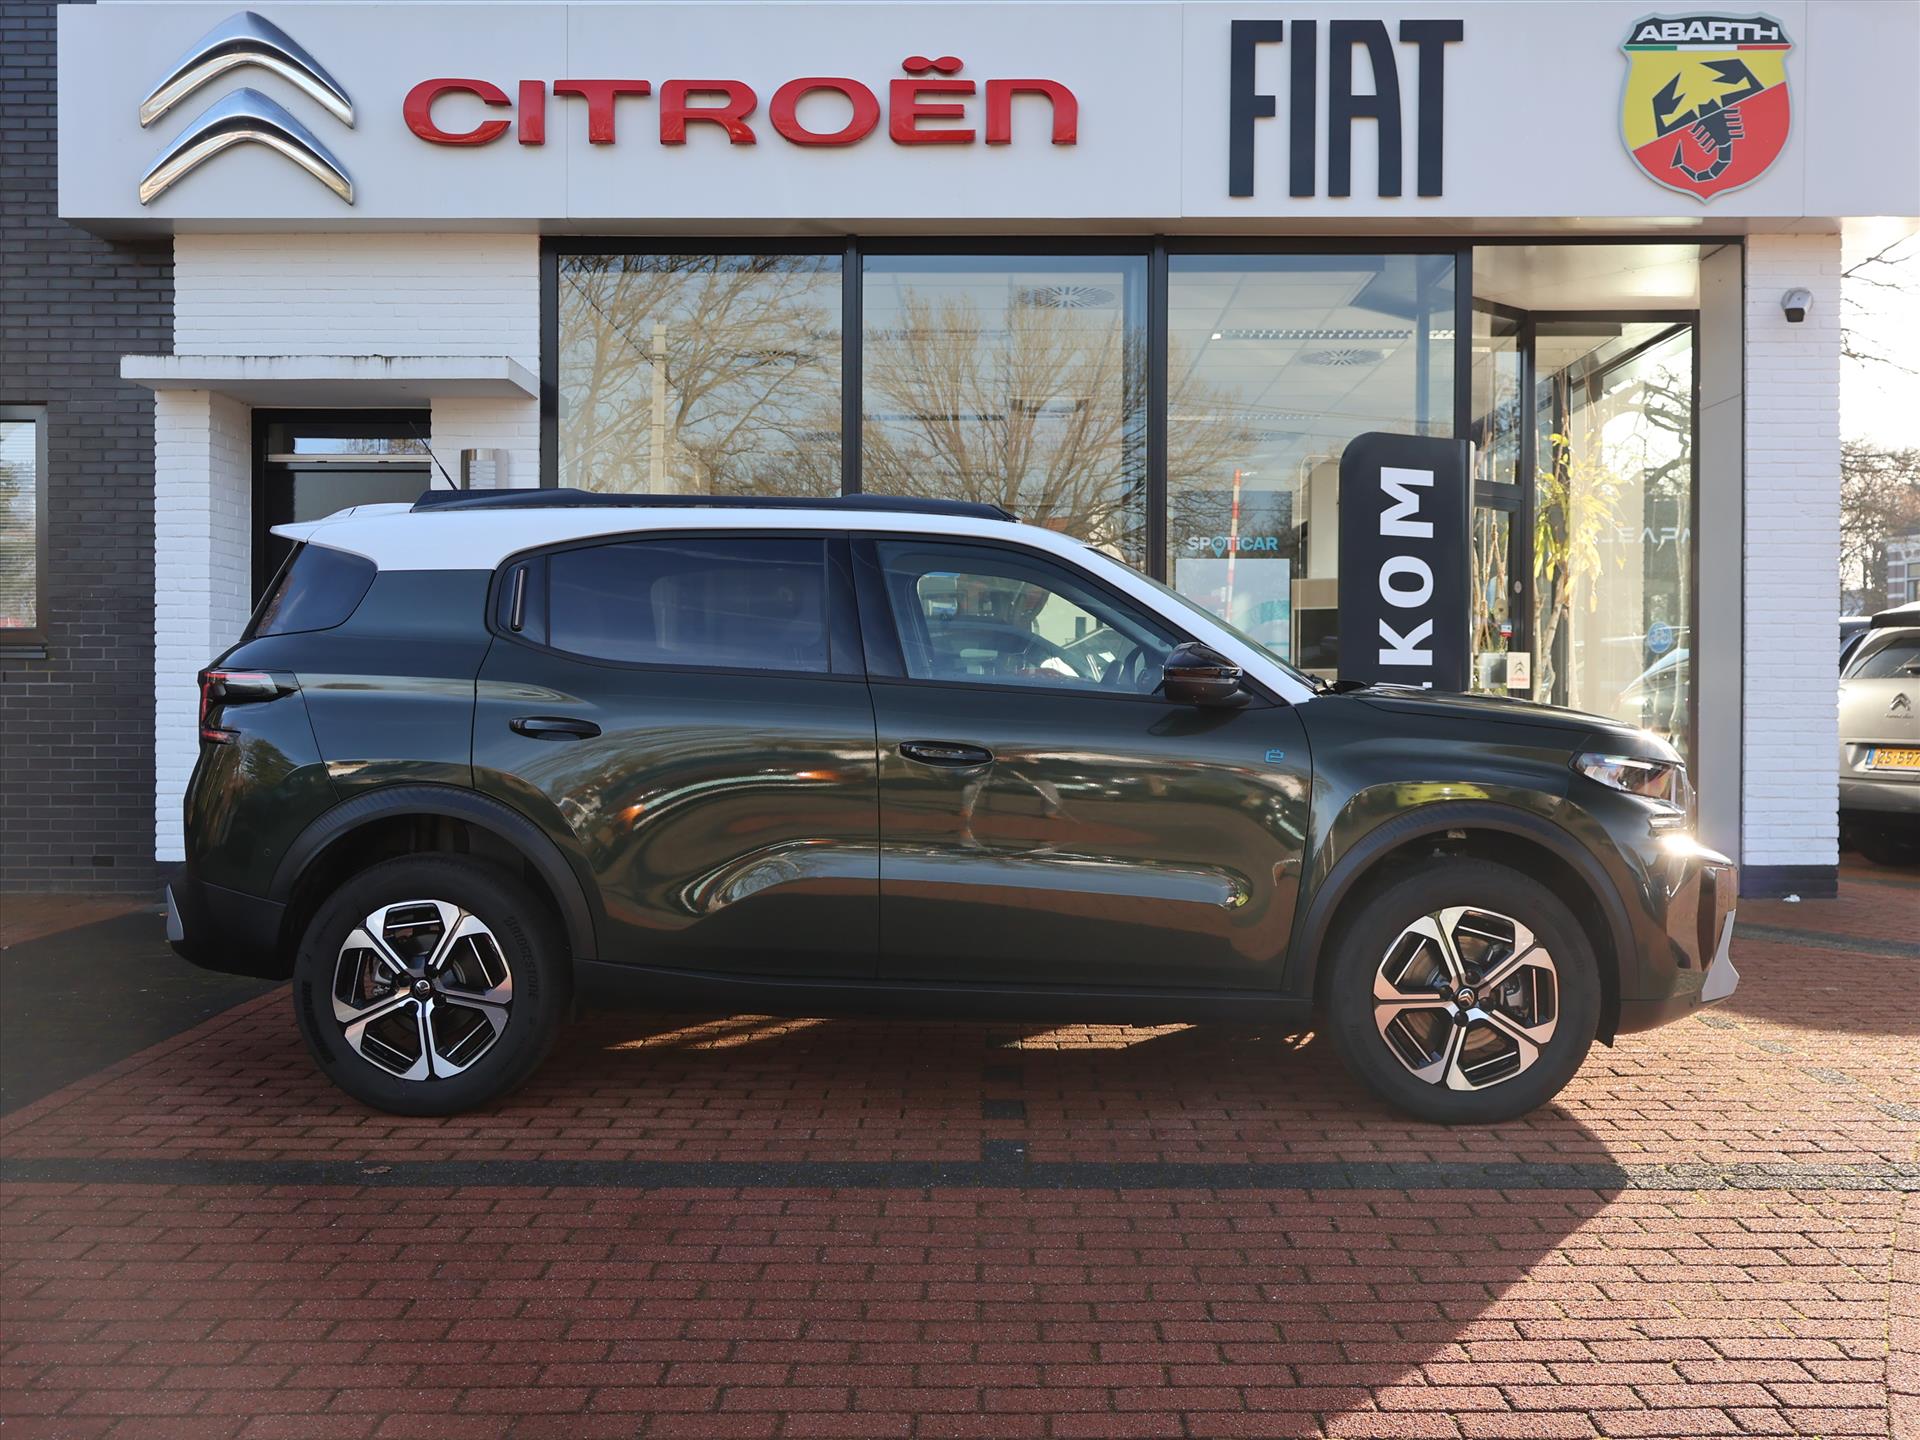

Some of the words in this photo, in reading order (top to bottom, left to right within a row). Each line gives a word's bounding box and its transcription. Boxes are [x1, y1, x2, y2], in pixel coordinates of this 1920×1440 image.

[1229, 20, 1464, 197] FIAT
[1635, 21, 1779, 41] ABARTH
[1378, 466, 1434, 689] KOM
